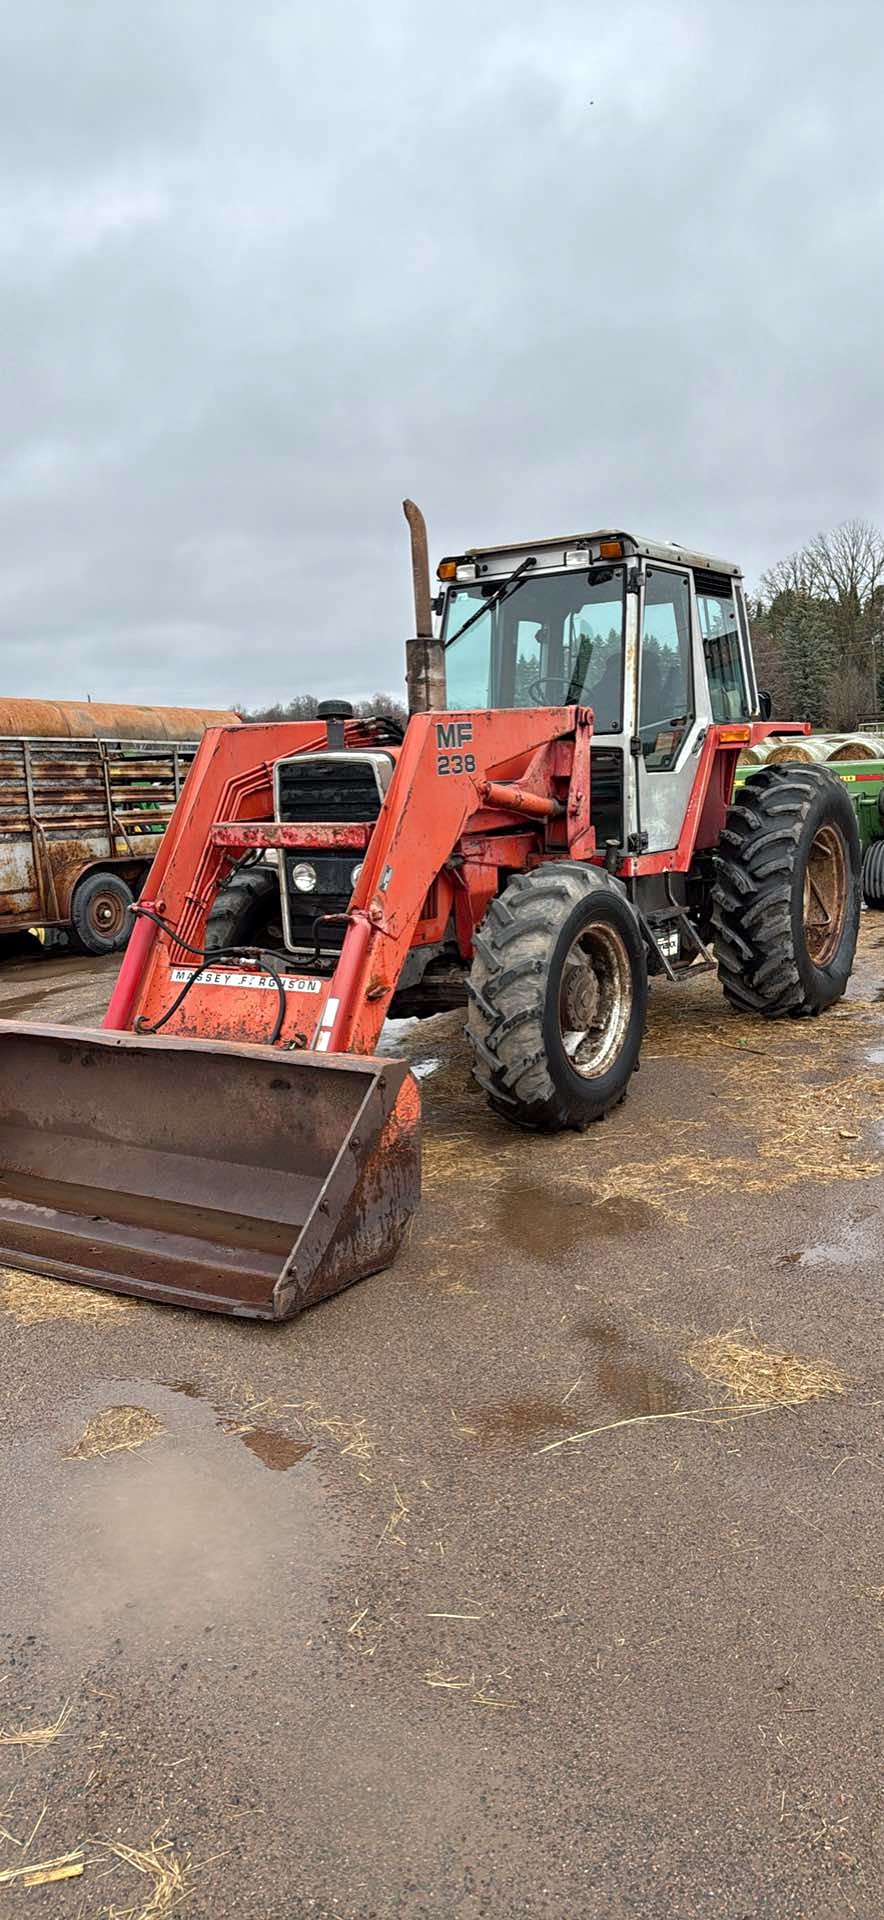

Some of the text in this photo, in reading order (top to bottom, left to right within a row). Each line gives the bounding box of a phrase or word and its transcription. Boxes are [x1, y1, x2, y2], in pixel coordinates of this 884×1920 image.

[436, 722, 473, 750] MF
[437, 754, 476, 775] 238
[175, 971, 231, 984] MASSEY
